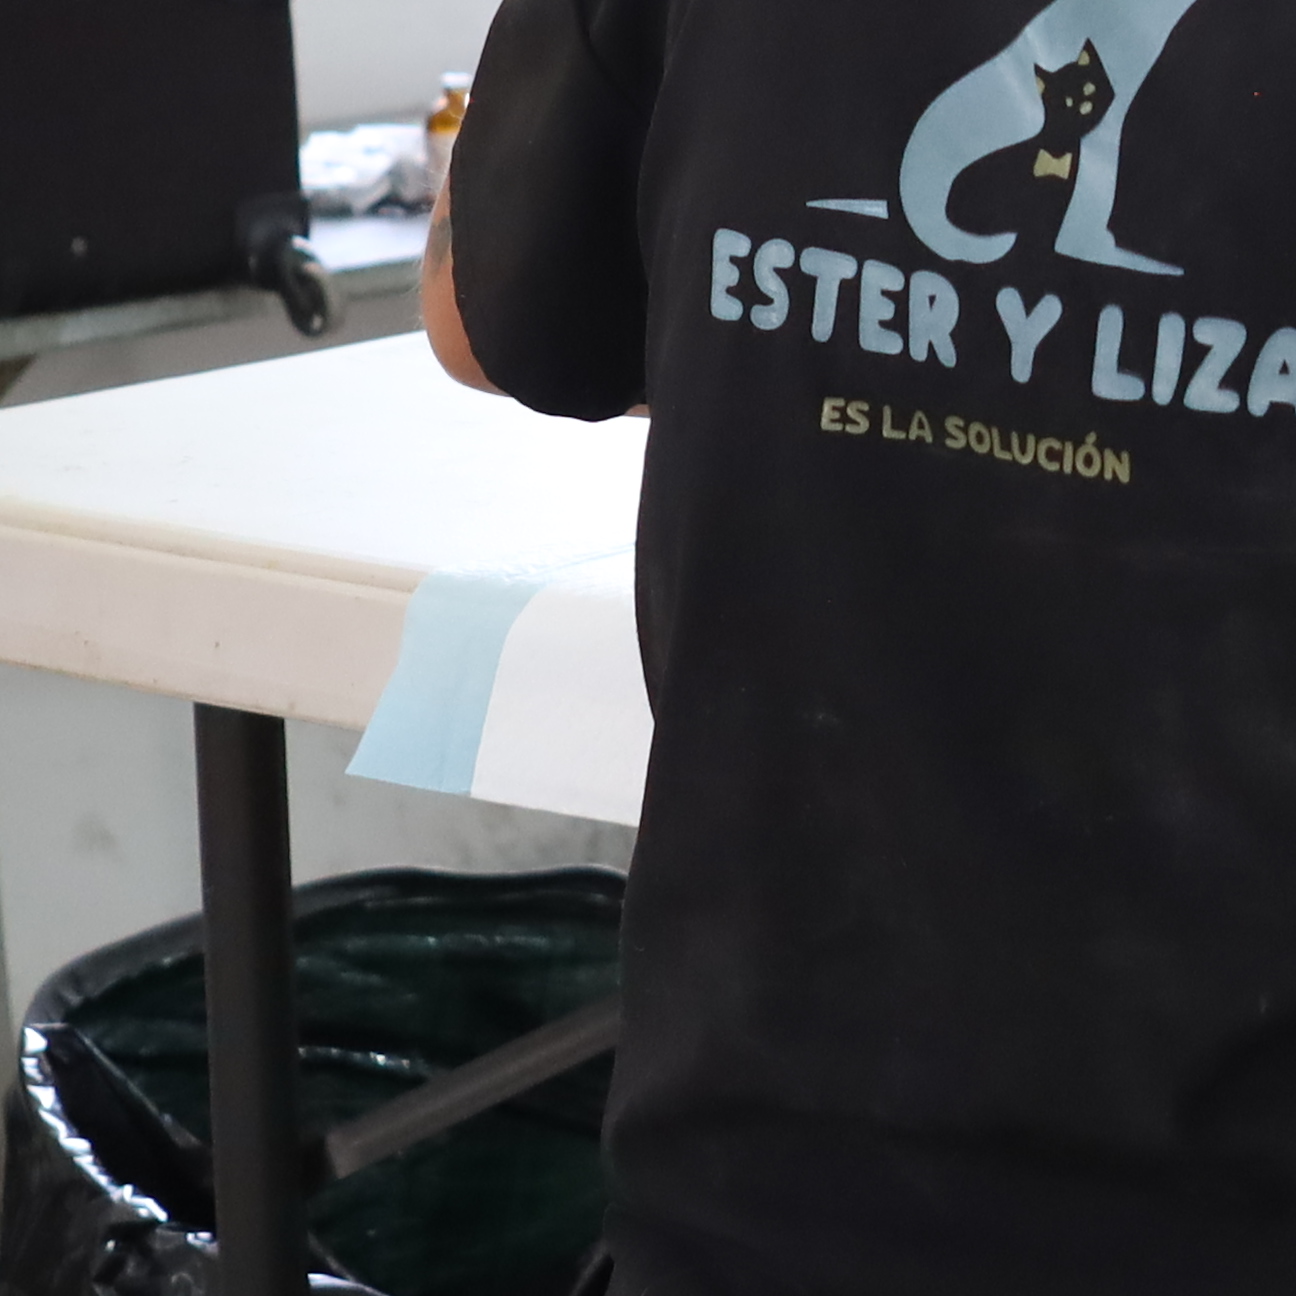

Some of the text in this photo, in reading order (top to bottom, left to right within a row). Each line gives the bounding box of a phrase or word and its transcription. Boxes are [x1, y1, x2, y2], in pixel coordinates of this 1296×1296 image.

[709, 227, 961, 369] ESTER
[995, 286, 1063, 384] Y
[820, 397, 1132, 484] ES LA SOLUCIÓN
